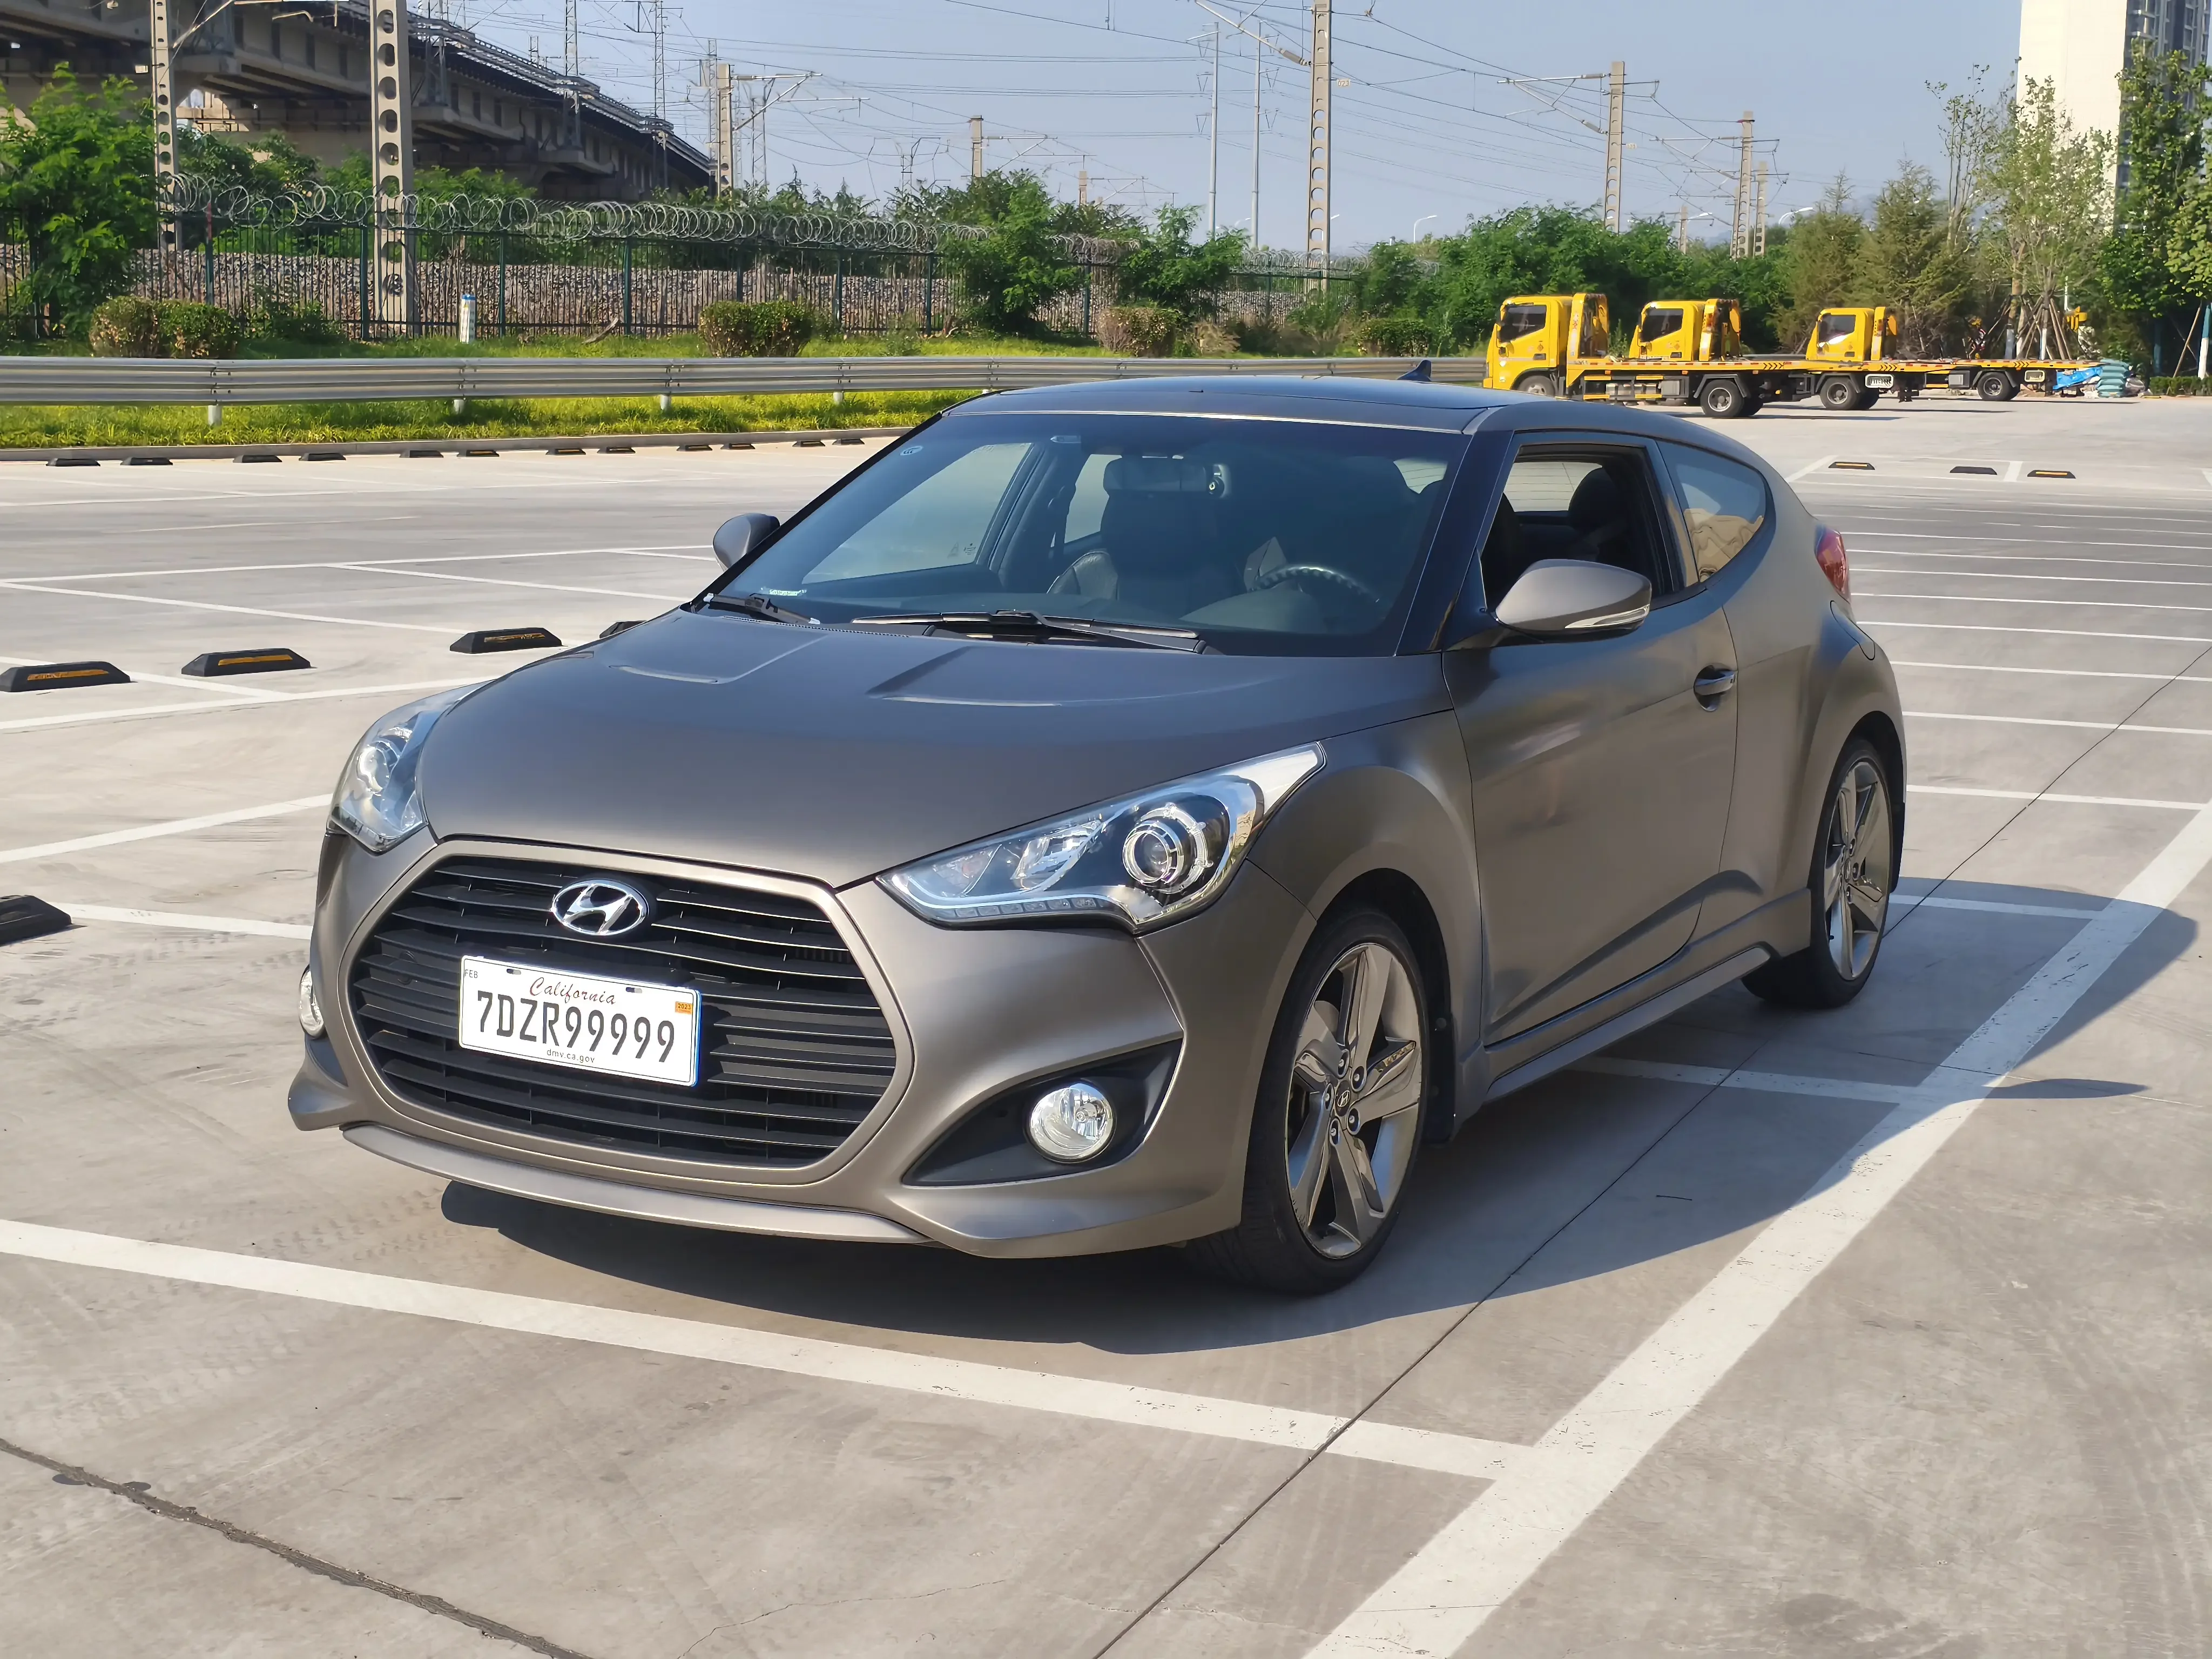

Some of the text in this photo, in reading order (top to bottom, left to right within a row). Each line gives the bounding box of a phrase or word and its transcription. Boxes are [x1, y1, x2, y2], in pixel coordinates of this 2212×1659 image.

[529, 977, 616, 1005] California
[477, 990, 675, 1063] 7DZR99999
[547, 1049, 595, 1063] dmv.ca.gov
